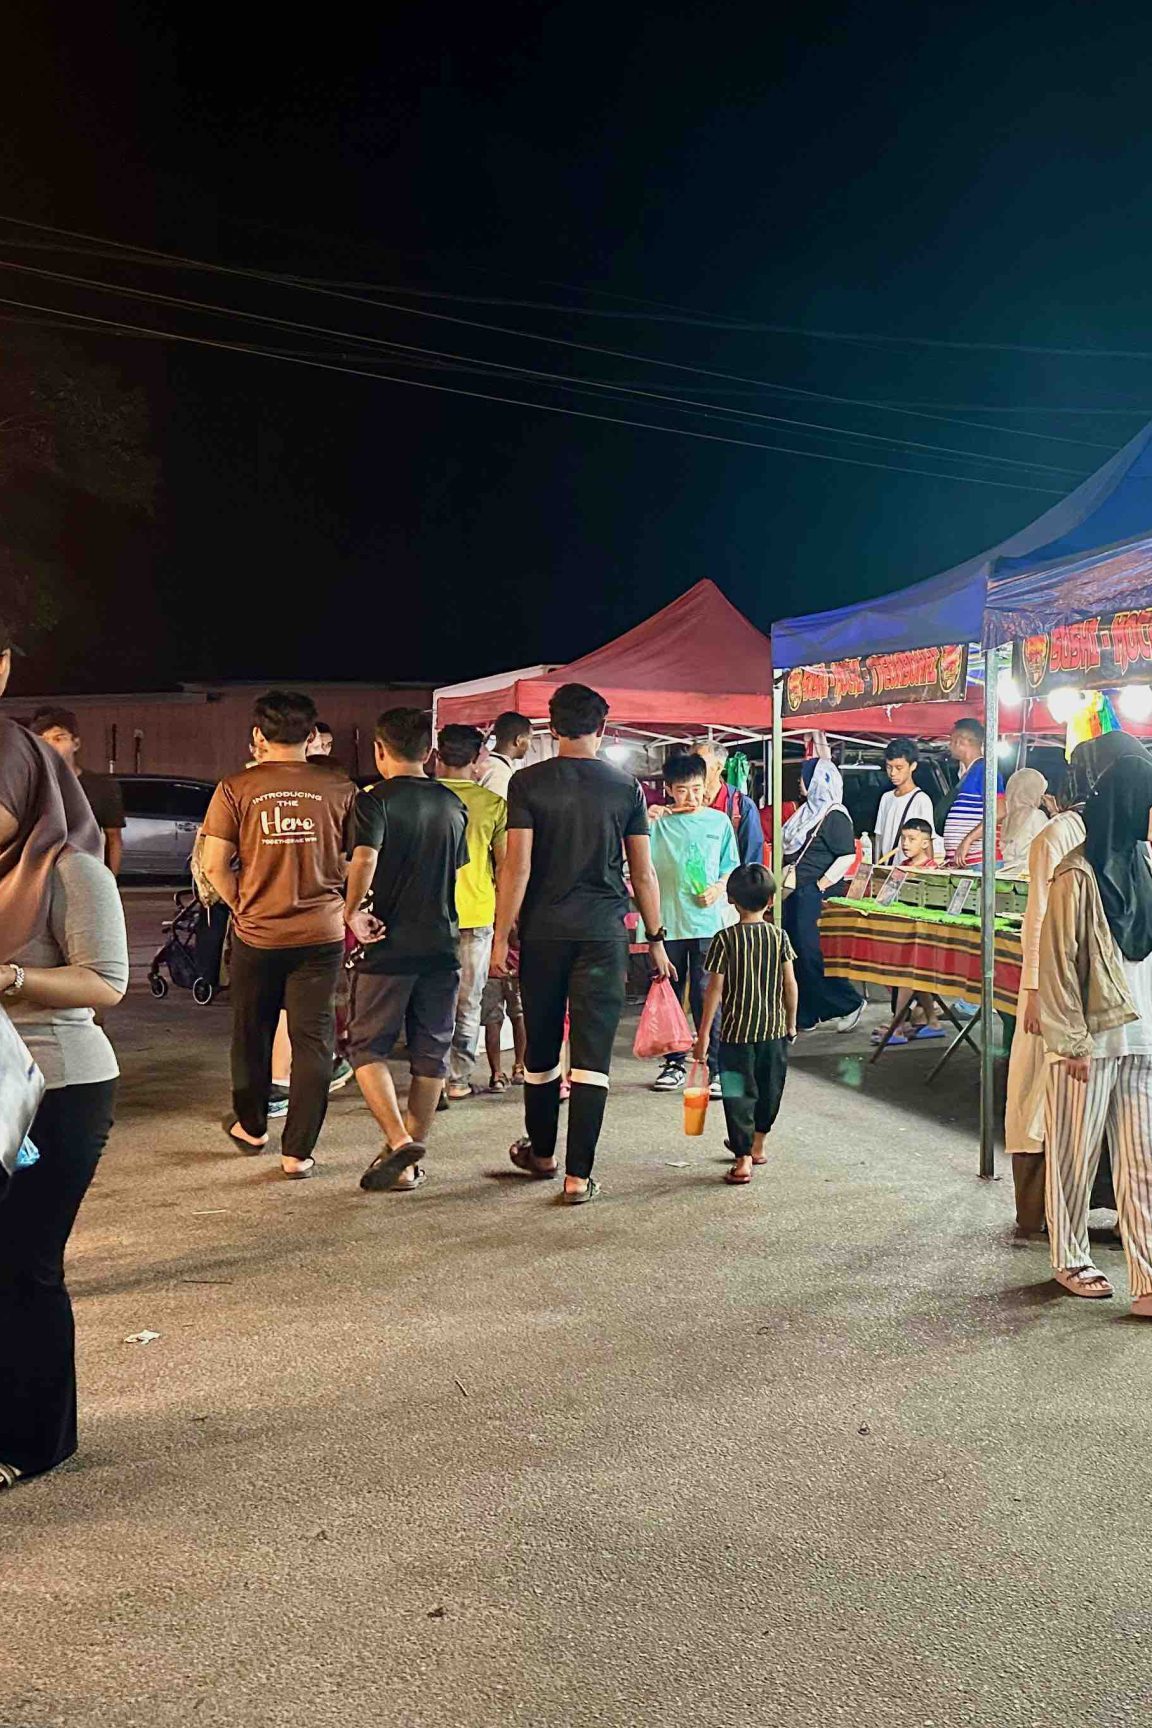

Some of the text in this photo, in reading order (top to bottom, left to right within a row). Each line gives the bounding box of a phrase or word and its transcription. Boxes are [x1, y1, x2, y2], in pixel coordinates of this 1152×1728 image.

[1049, 617, 1101, 674] SUSHI
[252, 791, 322, 805] INTRODUCING
[261, 806, 315, 835] Hero
